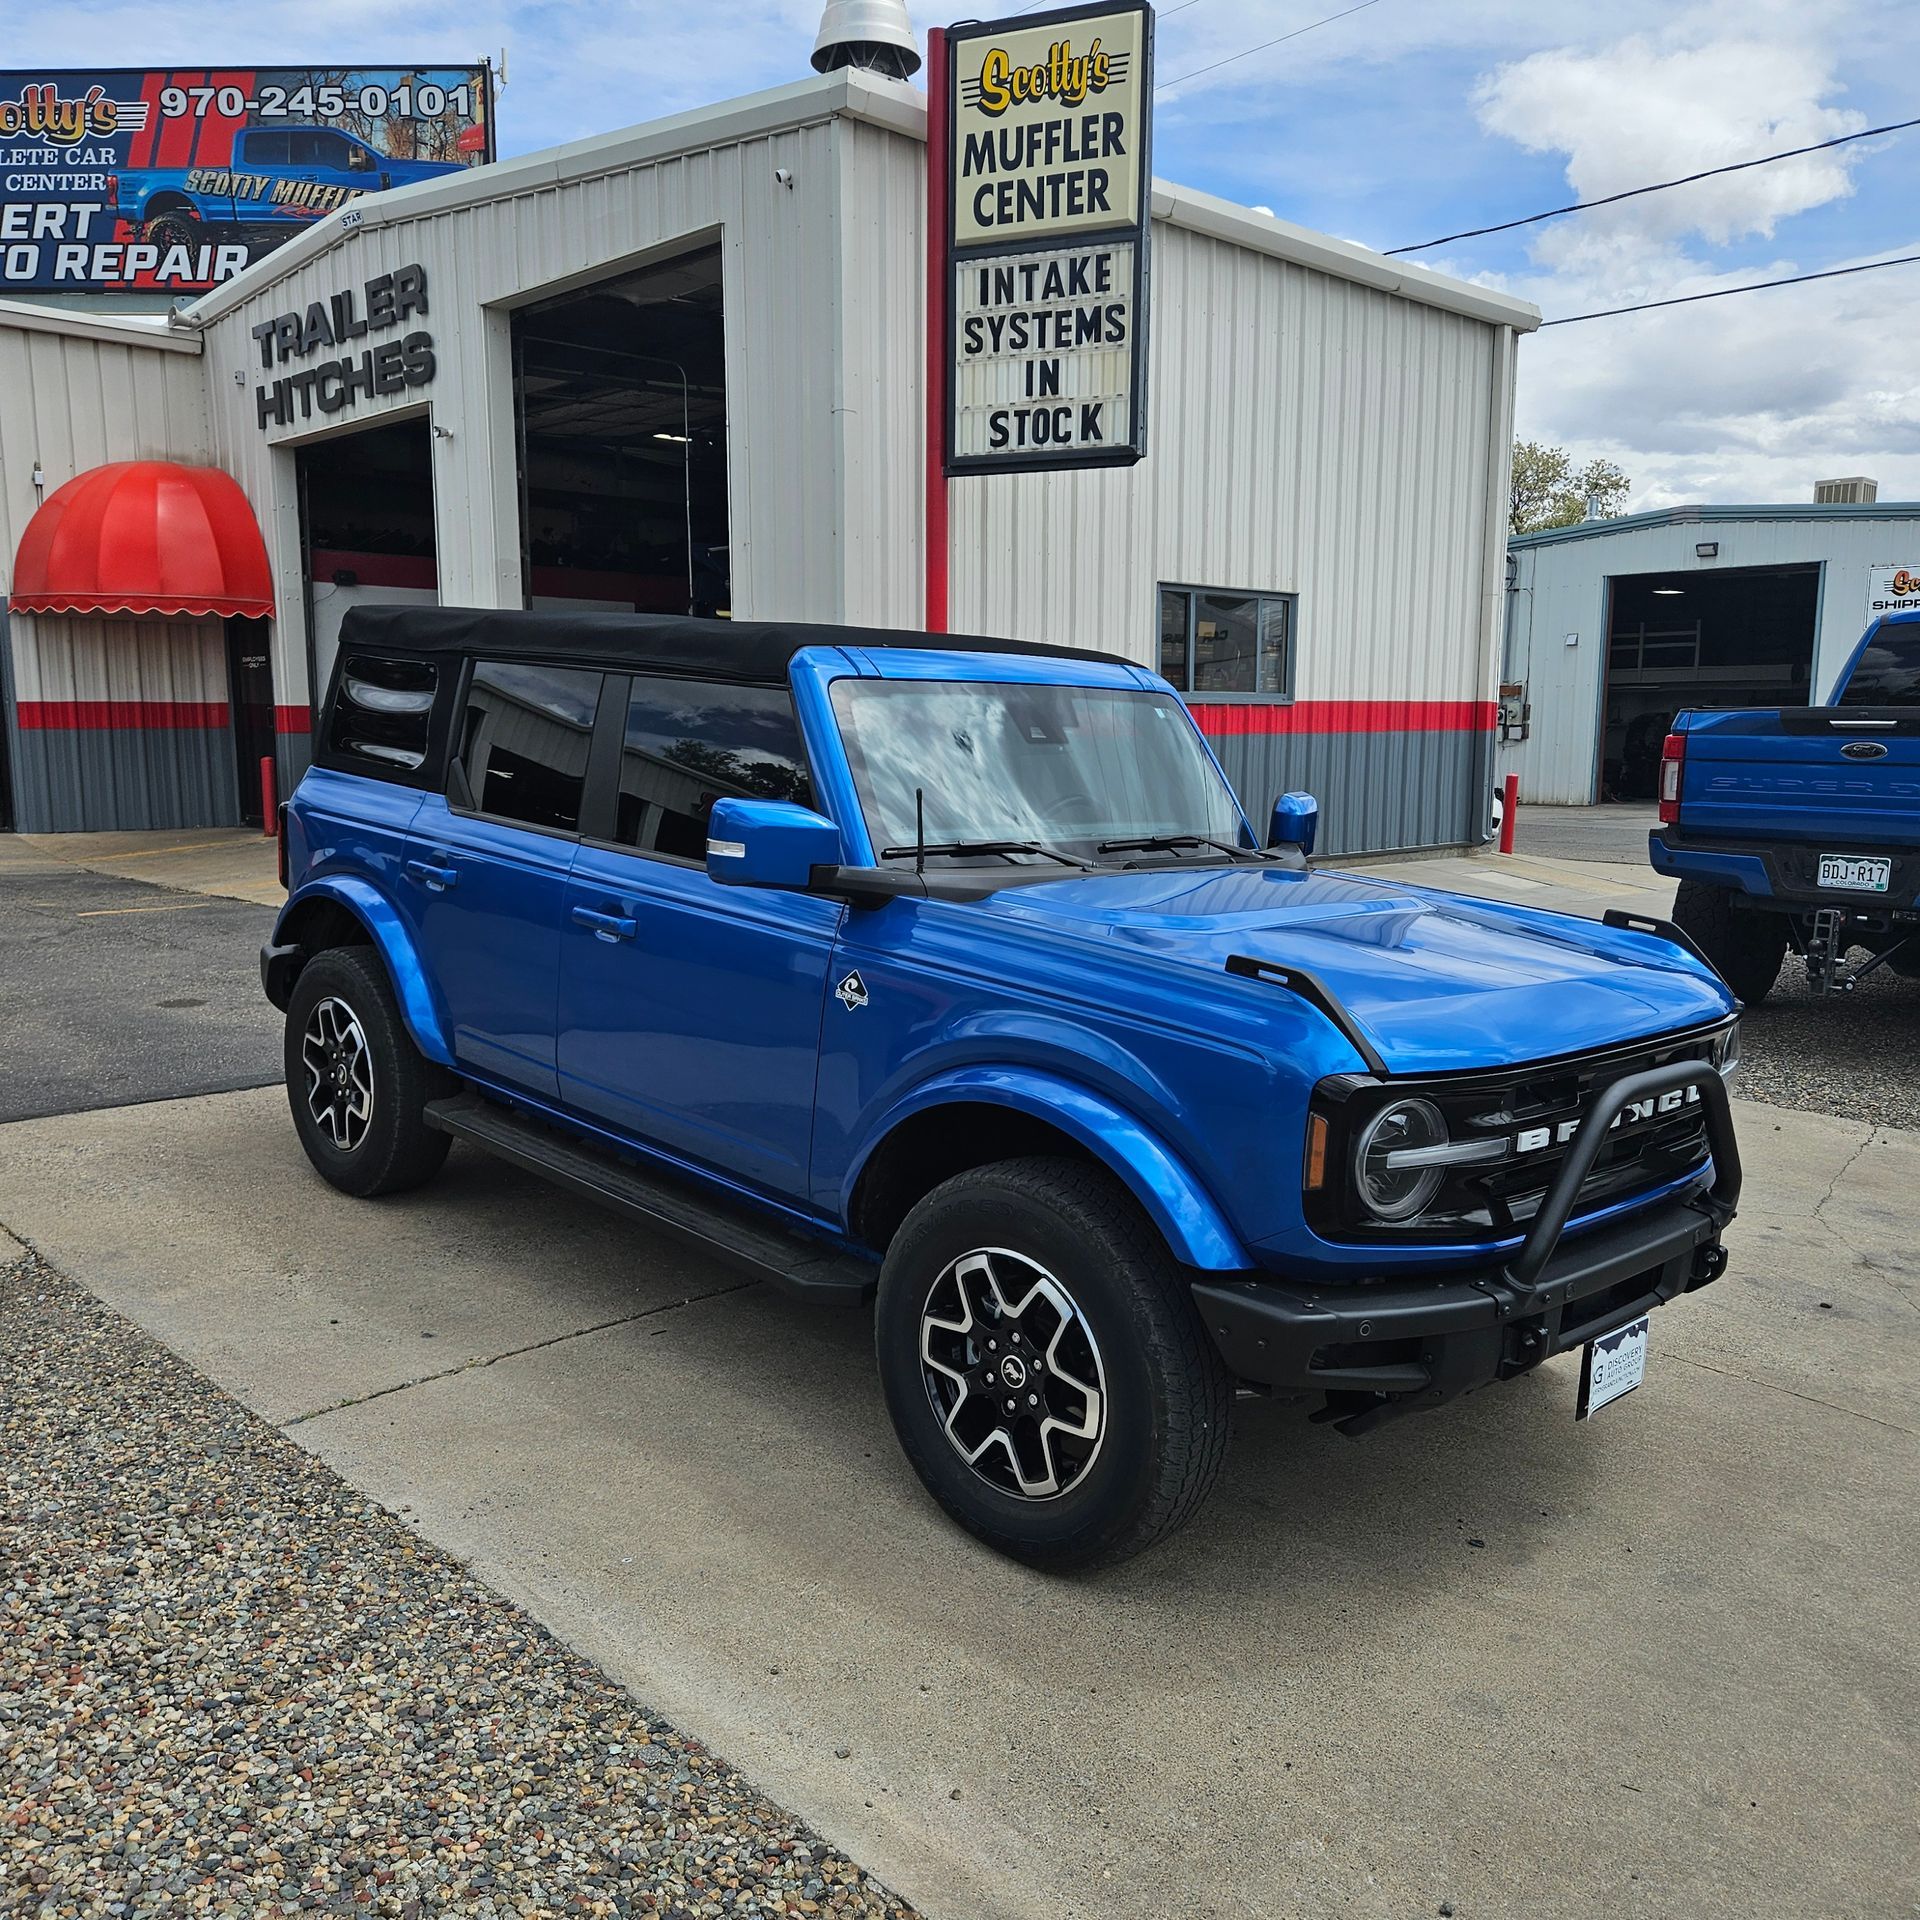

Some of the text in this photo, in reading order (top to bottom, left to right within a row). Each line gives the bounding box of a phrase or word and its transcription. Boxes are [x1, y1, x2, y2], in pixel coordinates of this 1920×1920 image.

[979, 37, 1111, 118] Scotty's
[159, 85, 470, 117] 970-245-0101
[65, 147, 117, 165] CAR
[962, 111, 1126, 178] MUFFLER
[5, 173, 107, 191] CENTER
[184, 168, 377, 210] SCOTTY MUFFL
[973, 167, 1111, 228] CENTER
[0, 204, 101, 240] ERT
[342, 212, 362, 227] STAR
[53, 244, 249, 281] REPAIR
[980, 254, 1112, 306] INTAKE
[252, 263, 429, 369] TRAILER
[964, 303, 1126, 356] SYSTEMS
[256, 331, 437, 430] HITCHES
[1026, 359, 1060, 397] IN
[989, 403, 1103, 448] STOCK
[1711, 777, 1875, 793] SUPER
[1835, 879, 1870, 887] COLORADO
[1607, 1345, 1643, 1371] DISCOVERY
[1607, 1354, 1643, 1380] AUTO GROUP
